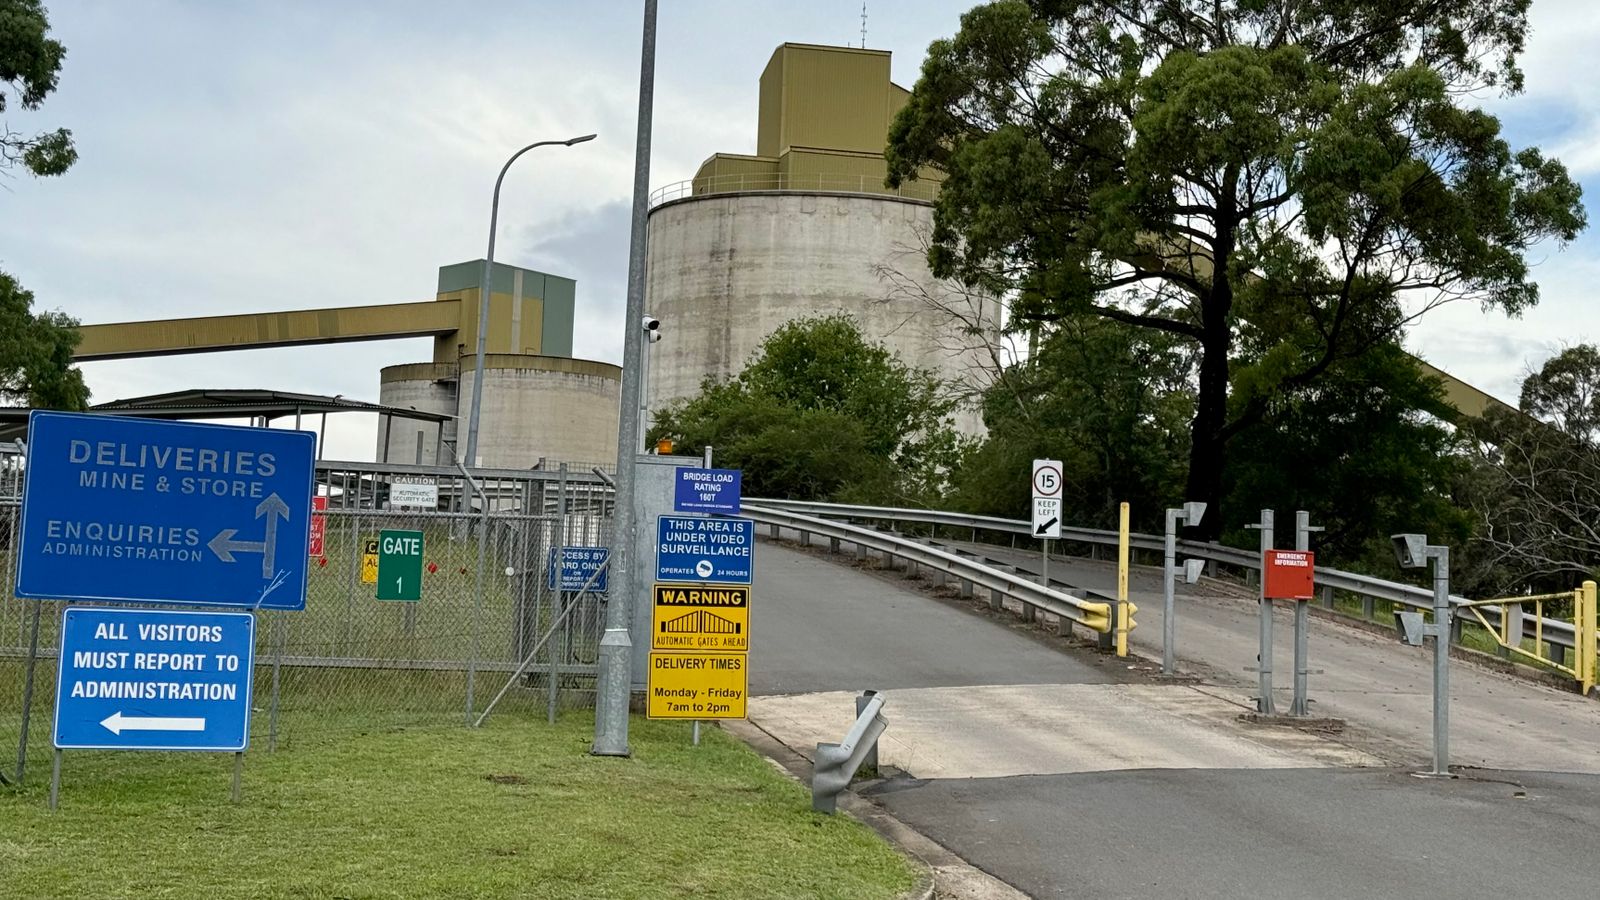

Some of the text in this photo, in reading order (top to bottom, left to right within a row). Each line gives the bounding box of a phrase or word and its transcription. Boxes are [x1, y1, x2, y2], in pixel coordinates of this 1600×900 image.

[69, 439, 276, 477] DELIVERIES
[79, 470, 263, 498] MINE & STORE
[394, 476, 435, 485] CAUTION
[683, 472, 734, 483] BRIDGE LOAD
[1041, 474, 1055, 488] 15
[694, 483, 721, 492] RATING
[47, 520, 200, 546] ENQUIRIES
[669, 520, 744, 533] THIS AREA IS
[666, 532, 745, 545] UNDER VIDEO
[42, 542, 202, 562] ADMINISTRATION
[383, 537, 420, 556] GATE
[661, 543, 749, 557] SURVEILLANCE
[592, 552, 605, 560] BY
[1274, 559, 1309, 567] INFORMATION
[660, 567, 694, 575] OPERATES
[396, 576, 402, 594] 1
[661, 590, 742, 605] WARNING
[94, 622, 223, 642] ALL VISITORS
[656, 636, 745, 647] AUTOMATIC GATES AHEAD
[73, 651, 239, 672] MUST REPORT TO
[655, 658, 741, 670] DELIVERY TIMES
[71, 680, 236, 700] ADMINISTRATION
[654, 688, 697, 700] Monday
[708, 688, 742, 699] Friday
[666, 702, 730, 714] 7am to 2pm
